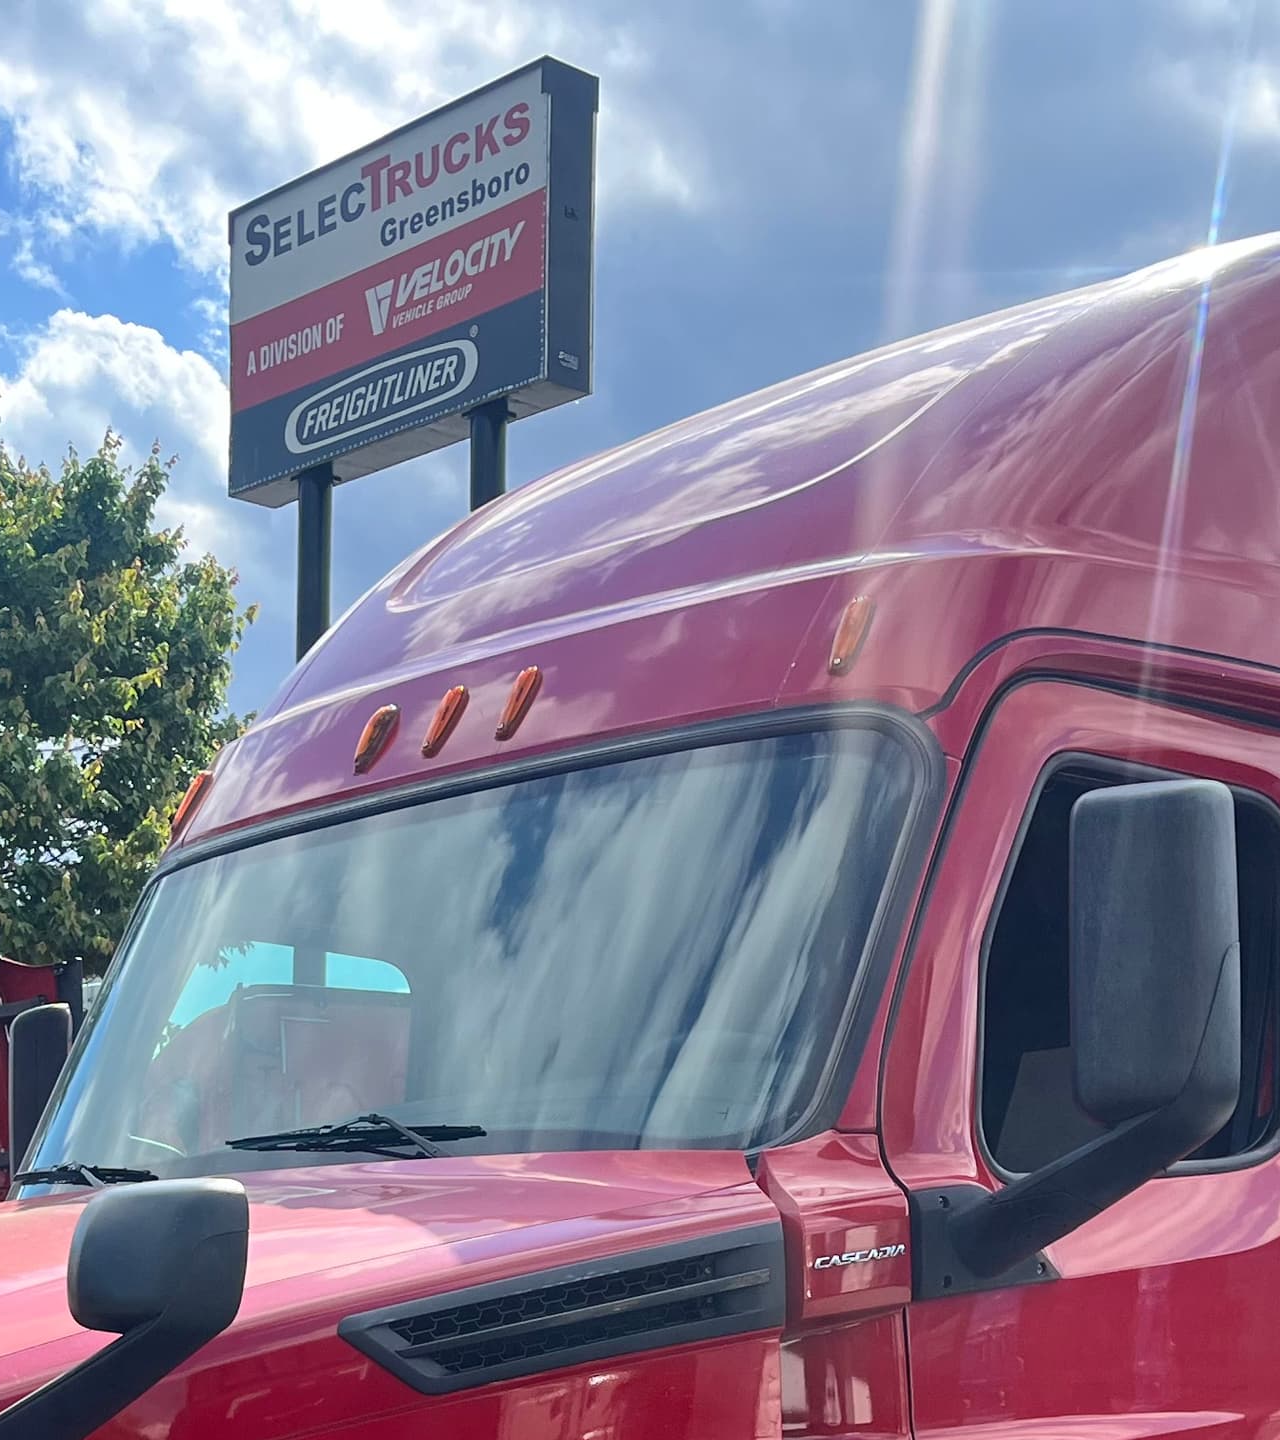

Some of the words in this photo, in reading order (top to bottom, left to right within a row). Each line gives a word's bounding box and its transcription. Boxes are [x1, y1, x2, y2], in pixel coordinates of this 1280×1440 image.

[380, 162, 530, 247] Greensboro
[395, 220, 526, 309] VELOCITY
[392, 300, 434, 329] VEHICLE
[436, 283, 473, 311] GROUP
[247, 351, 257, 377] A
[260, 324, 322, 372] DIVISION
[326, 313, 345, 345] OF
[302, 354, 459, 440] FREIGHTLINER
[814, 1243, 906, 1270] CASCADIA
